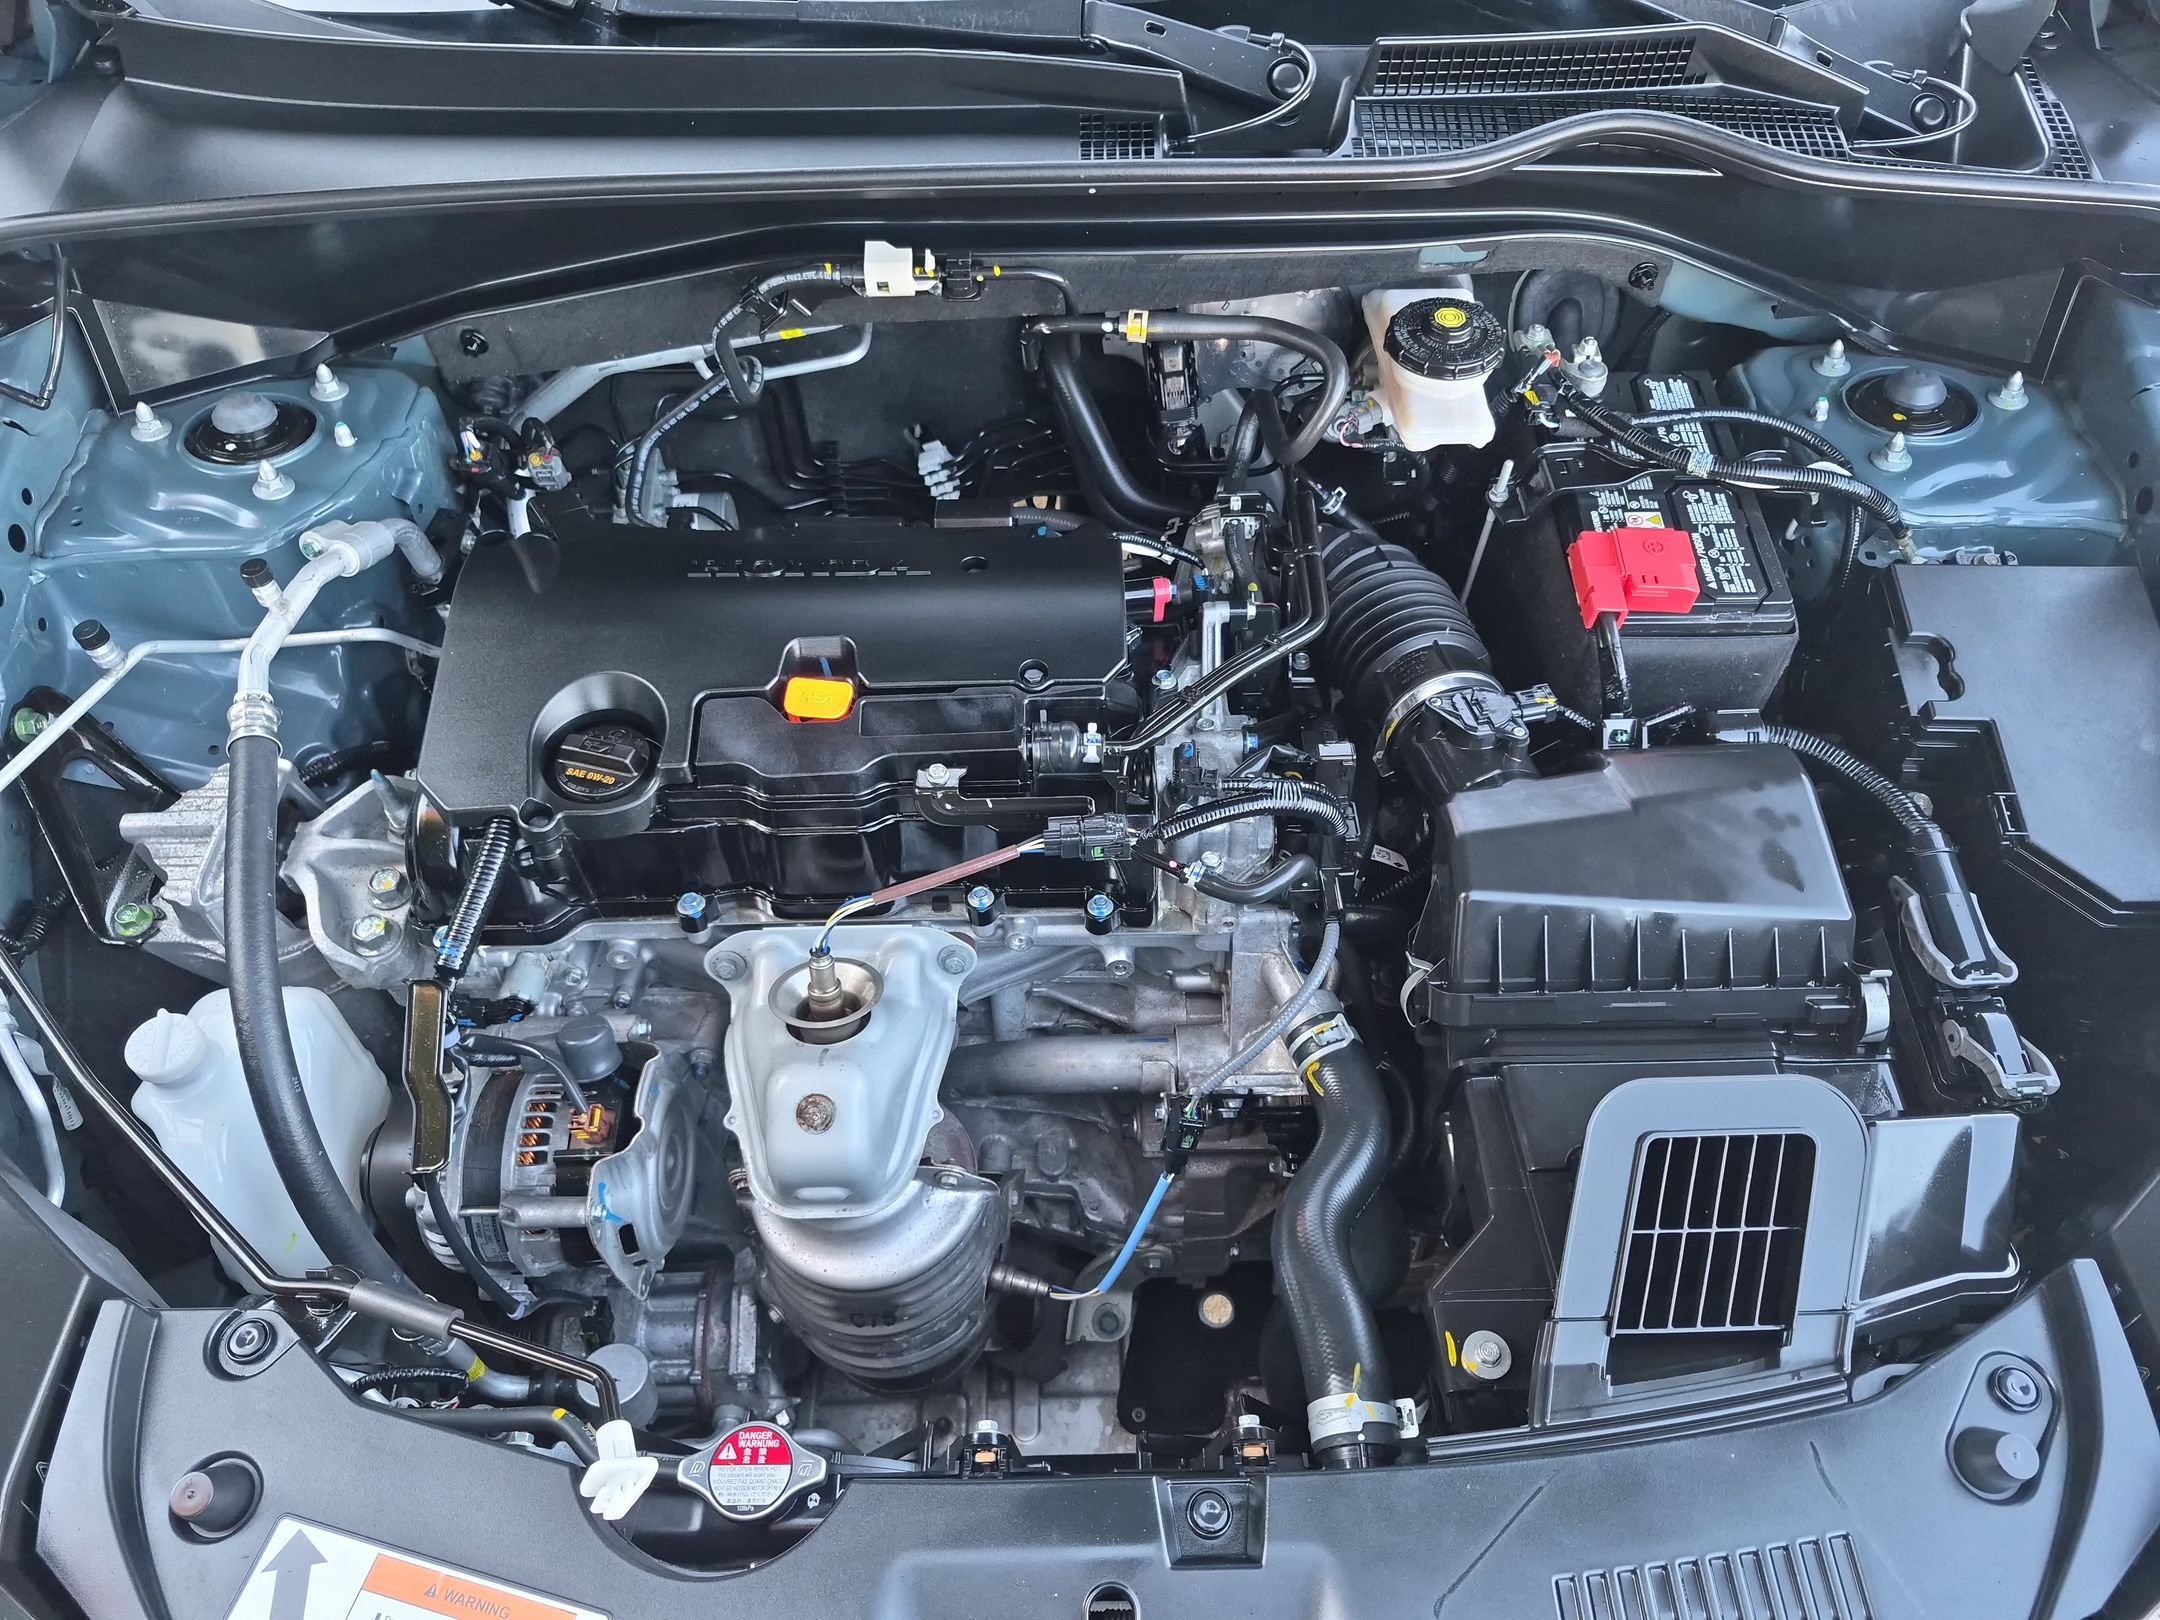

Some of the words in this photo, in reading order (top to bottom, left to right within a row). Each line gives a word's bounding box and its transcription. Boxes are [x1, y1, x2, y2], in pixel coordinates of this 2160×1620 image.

[565, 767, 586, 779] SAE
[586, 771, 616, 785] 0W-20
[738, 1431, 773, 1440] DANGER
[738, 1439, 780, 1448] WARNUNG
[444, 1588, 511, 1619] WARNING
